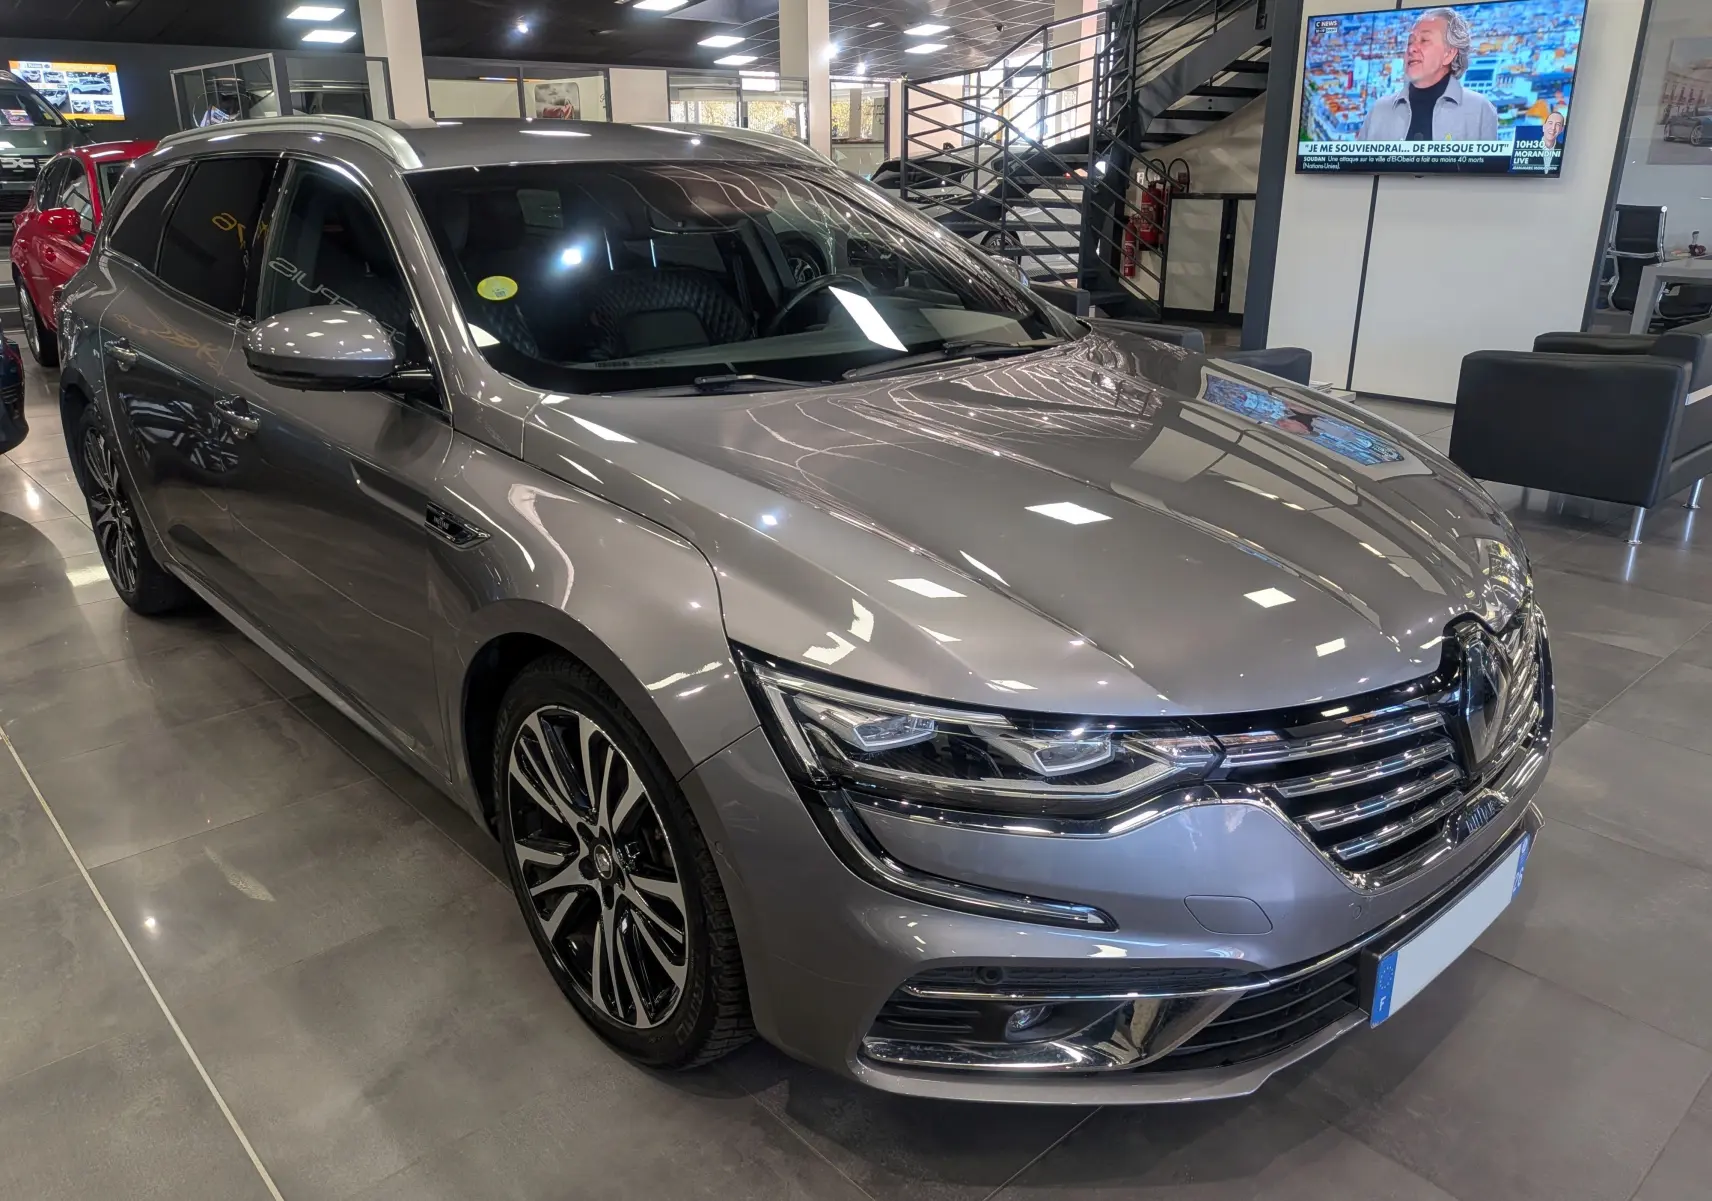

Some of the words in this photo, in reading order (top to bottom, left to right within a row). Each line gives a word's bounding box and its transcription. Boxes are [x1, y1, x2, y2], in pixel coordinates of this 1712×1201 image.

[1319, 143, 1333, 153] ME
[1335, 143, 1410, 153] SOUVIENDRAI...
[1412, 143, 1425, 153] DE
[1427, 143, 1475, 154] PRESQUE
[1476, 143, 1509, 153] TOUT"
[1515, 140, 1545, 149] 10H30
[1514, 150, 1562, 158] MORANDINI
[1339, 156, 1359, 164] attaque
[1379, 995, 1387, 1012] F
